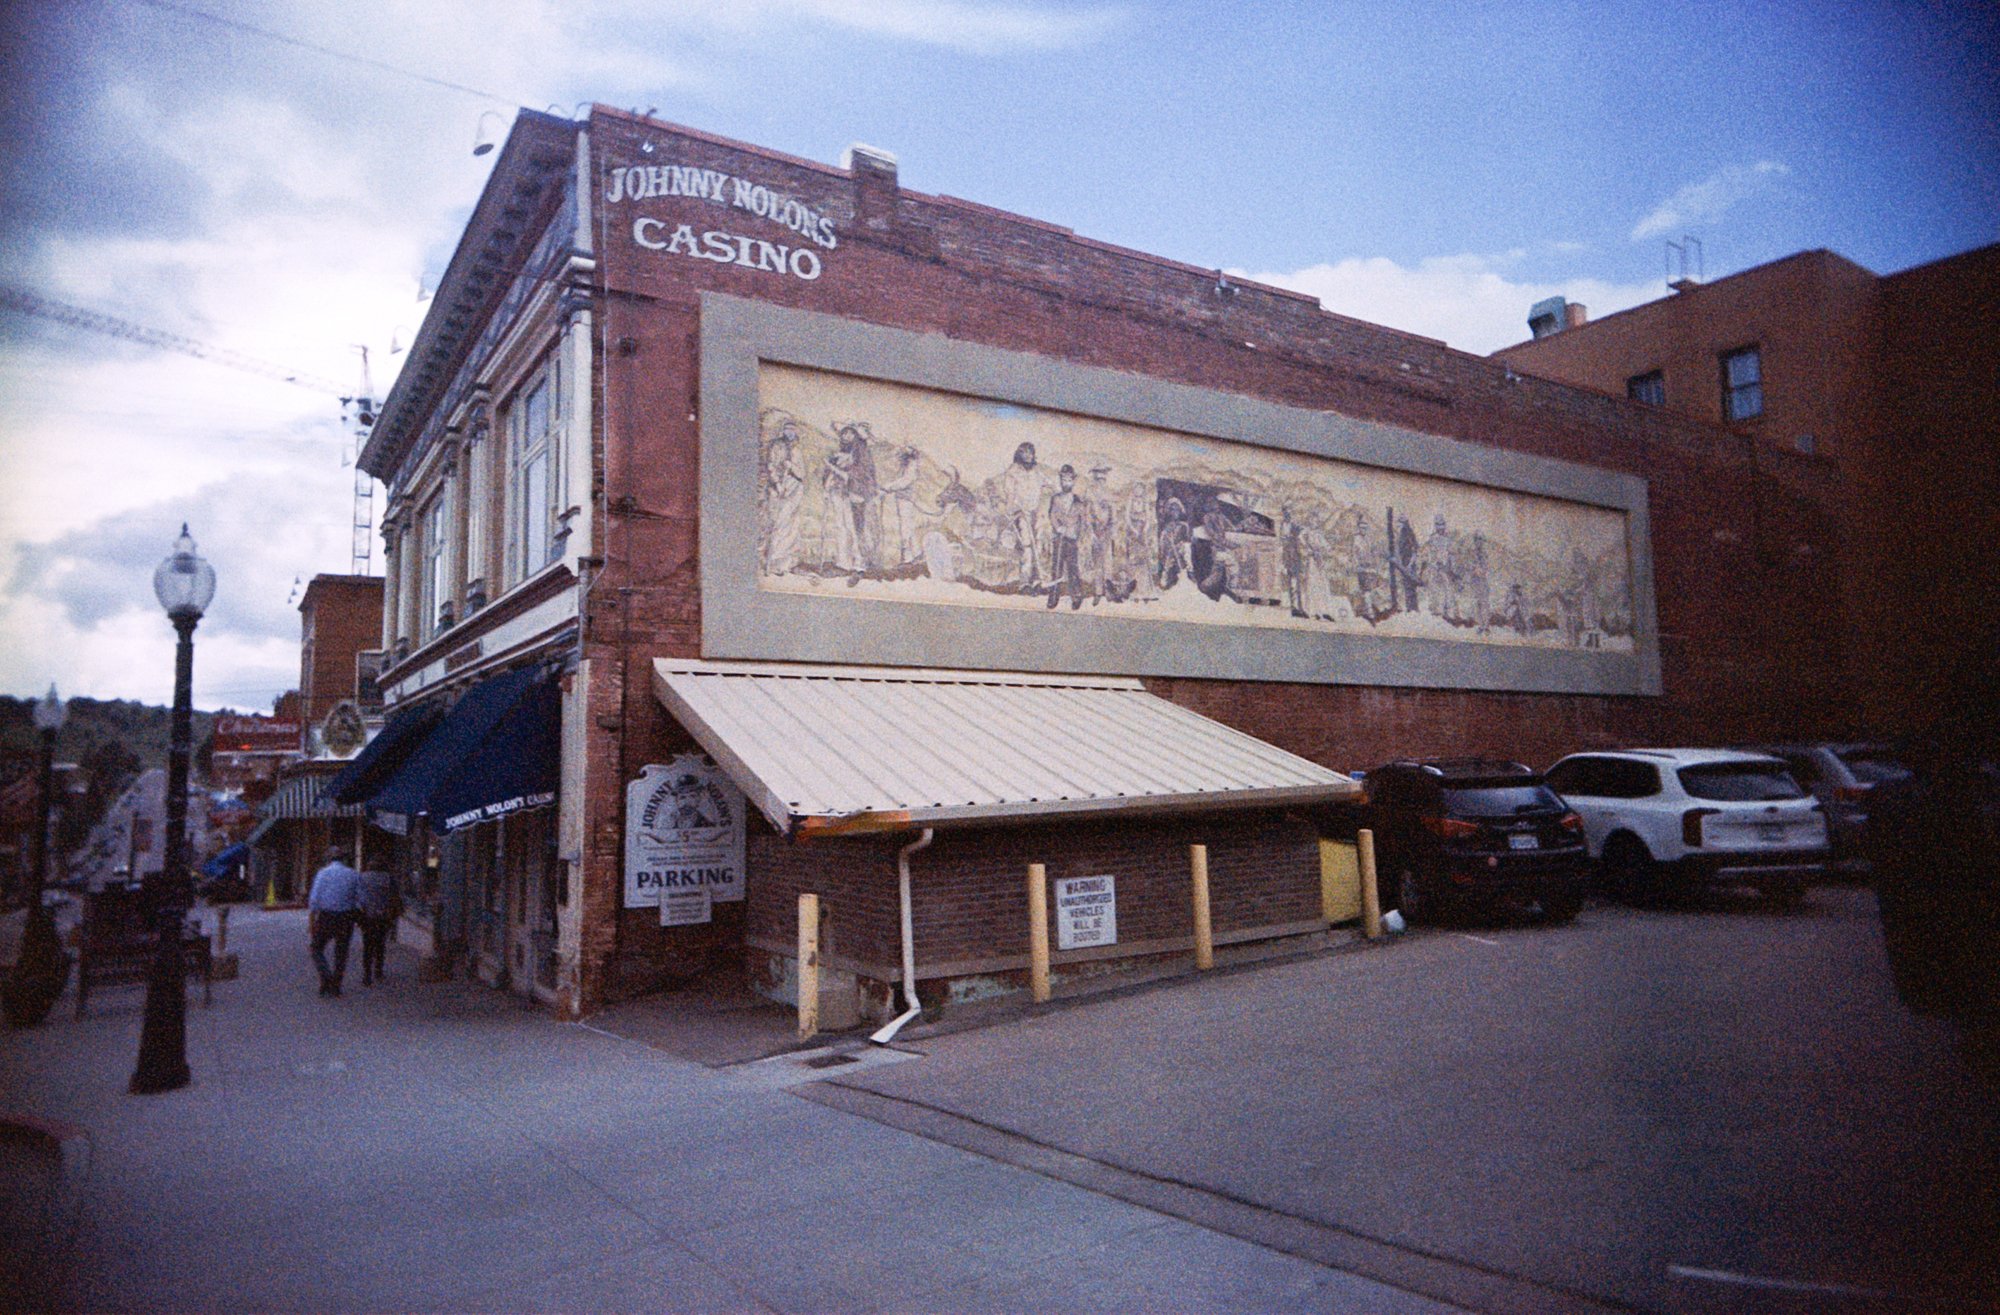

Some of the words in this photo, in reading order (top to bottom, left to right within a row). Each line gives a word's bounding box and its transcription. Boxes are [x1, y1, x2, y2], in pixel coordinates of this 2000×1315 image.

[606, 165, 729, 203] JOHNNY
[632, 217, 822, 280] CASINO
[445, 808, 482, 829] JOHNNY
[636, 867, 735, 888] PARKING
[1065, 879, 1106, 895] WARNING
[1070, 905, 1105, 918] VEHICLES
